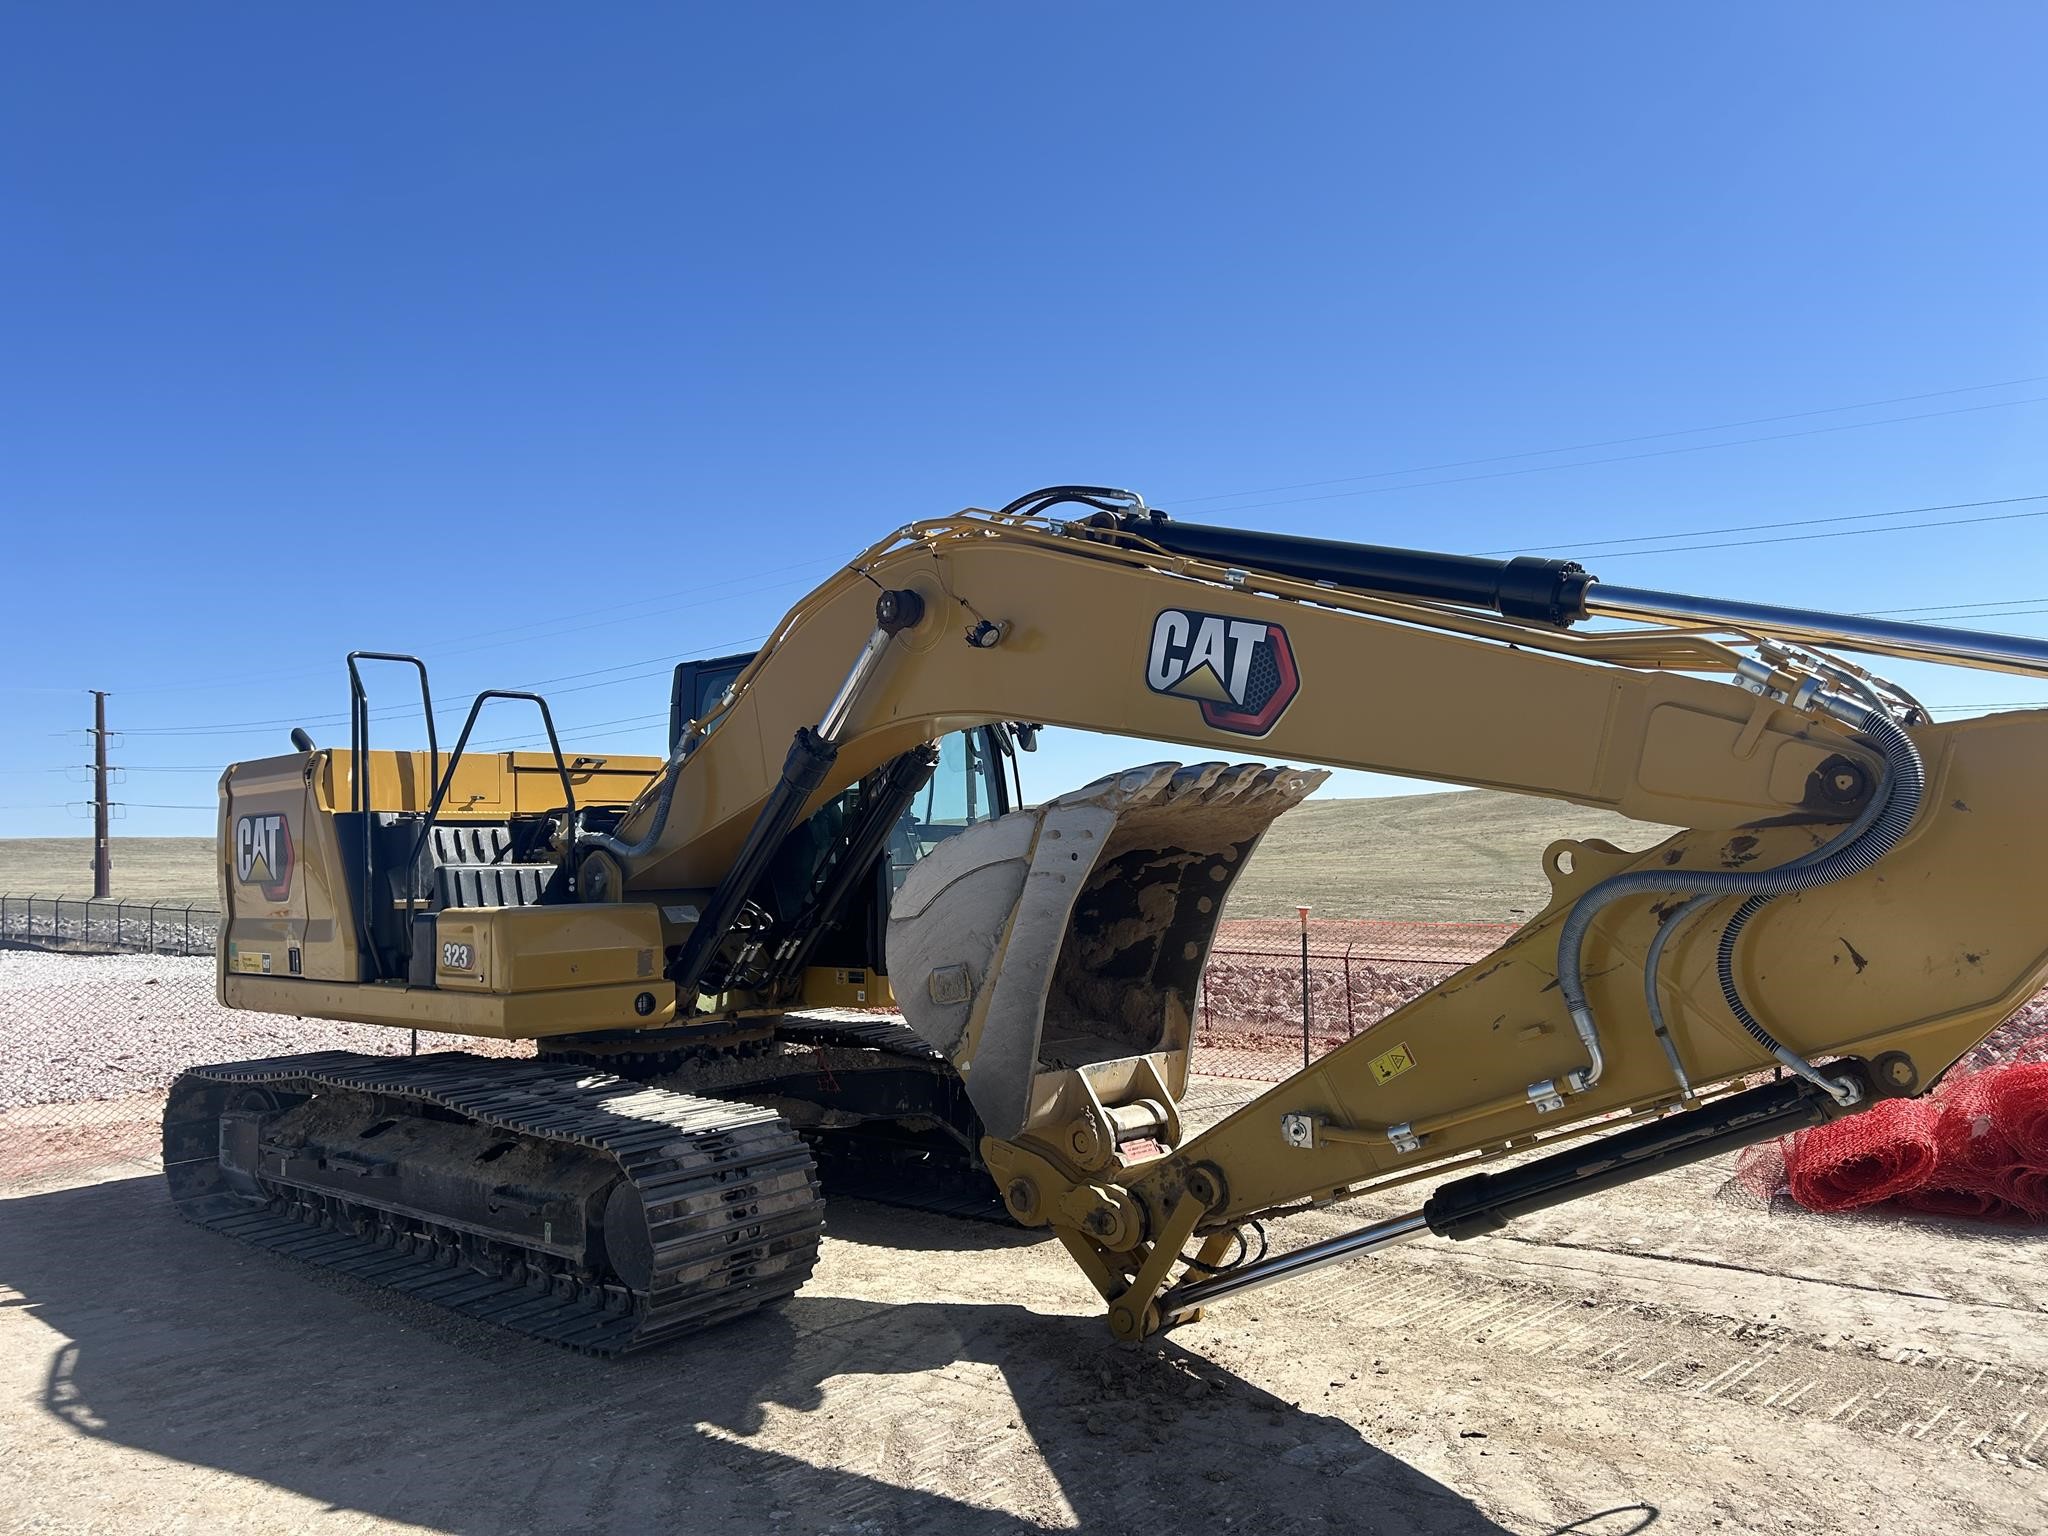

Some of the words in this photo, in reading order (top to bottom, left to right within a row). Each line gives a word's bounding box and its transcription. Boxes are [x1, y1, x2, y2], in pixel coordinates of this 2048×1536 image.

[1148, 610, 1268, 706] CAT
[237, 816, 281, 881] CAT
[443, 943, 468, 968] 323
